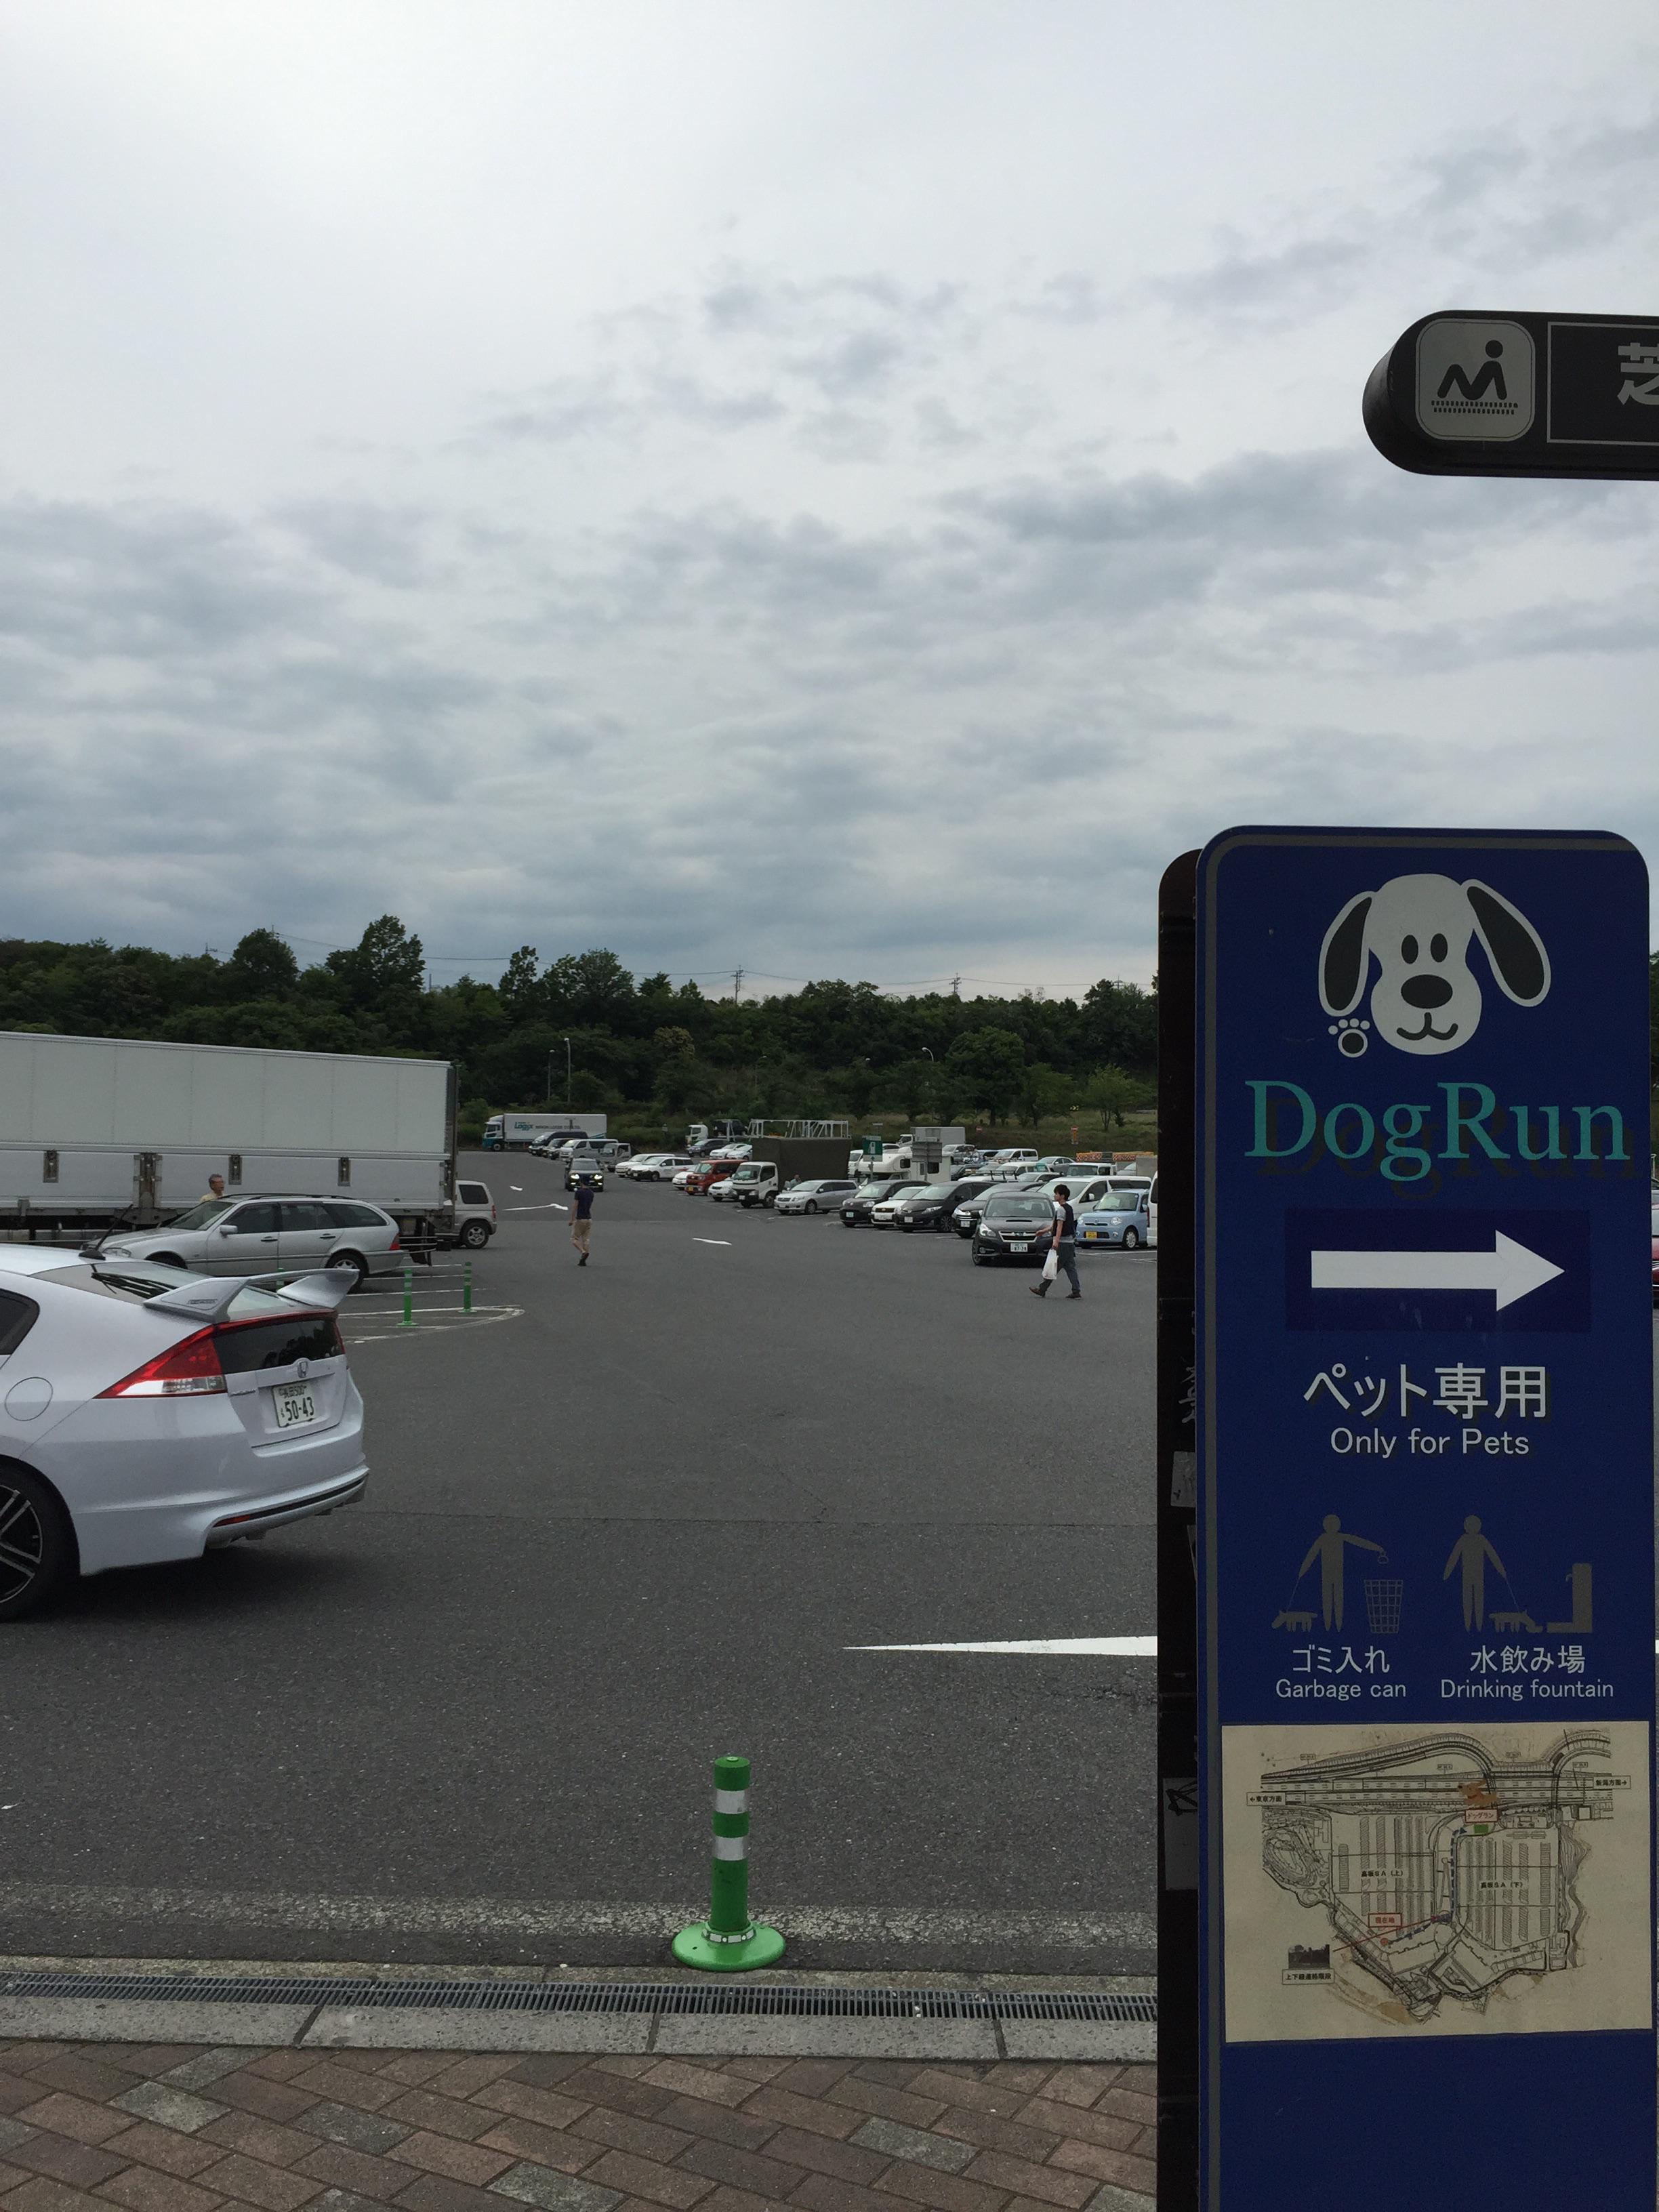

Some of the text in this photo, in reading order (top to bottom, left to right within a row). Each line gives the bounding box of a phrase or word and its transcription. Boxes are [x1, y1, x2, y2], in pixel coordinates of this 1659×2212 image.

[1244, 1080, 1631, 1182] DogRun
[1303, 1361, 1548, 1419] ペット専用
[285, 1397, 314, 1421] 50-43
[1330, 1427, 1530, 1458] Only for Pets
[1292, 1645, 1391, 1675] ゴミ入れ
[1469, 1645, 1586, 1675] 水飲み場
[1275, 1678, 1407, 1702] Garbage can
[1440, 1678, 1614, 1702] Drinking fountain
